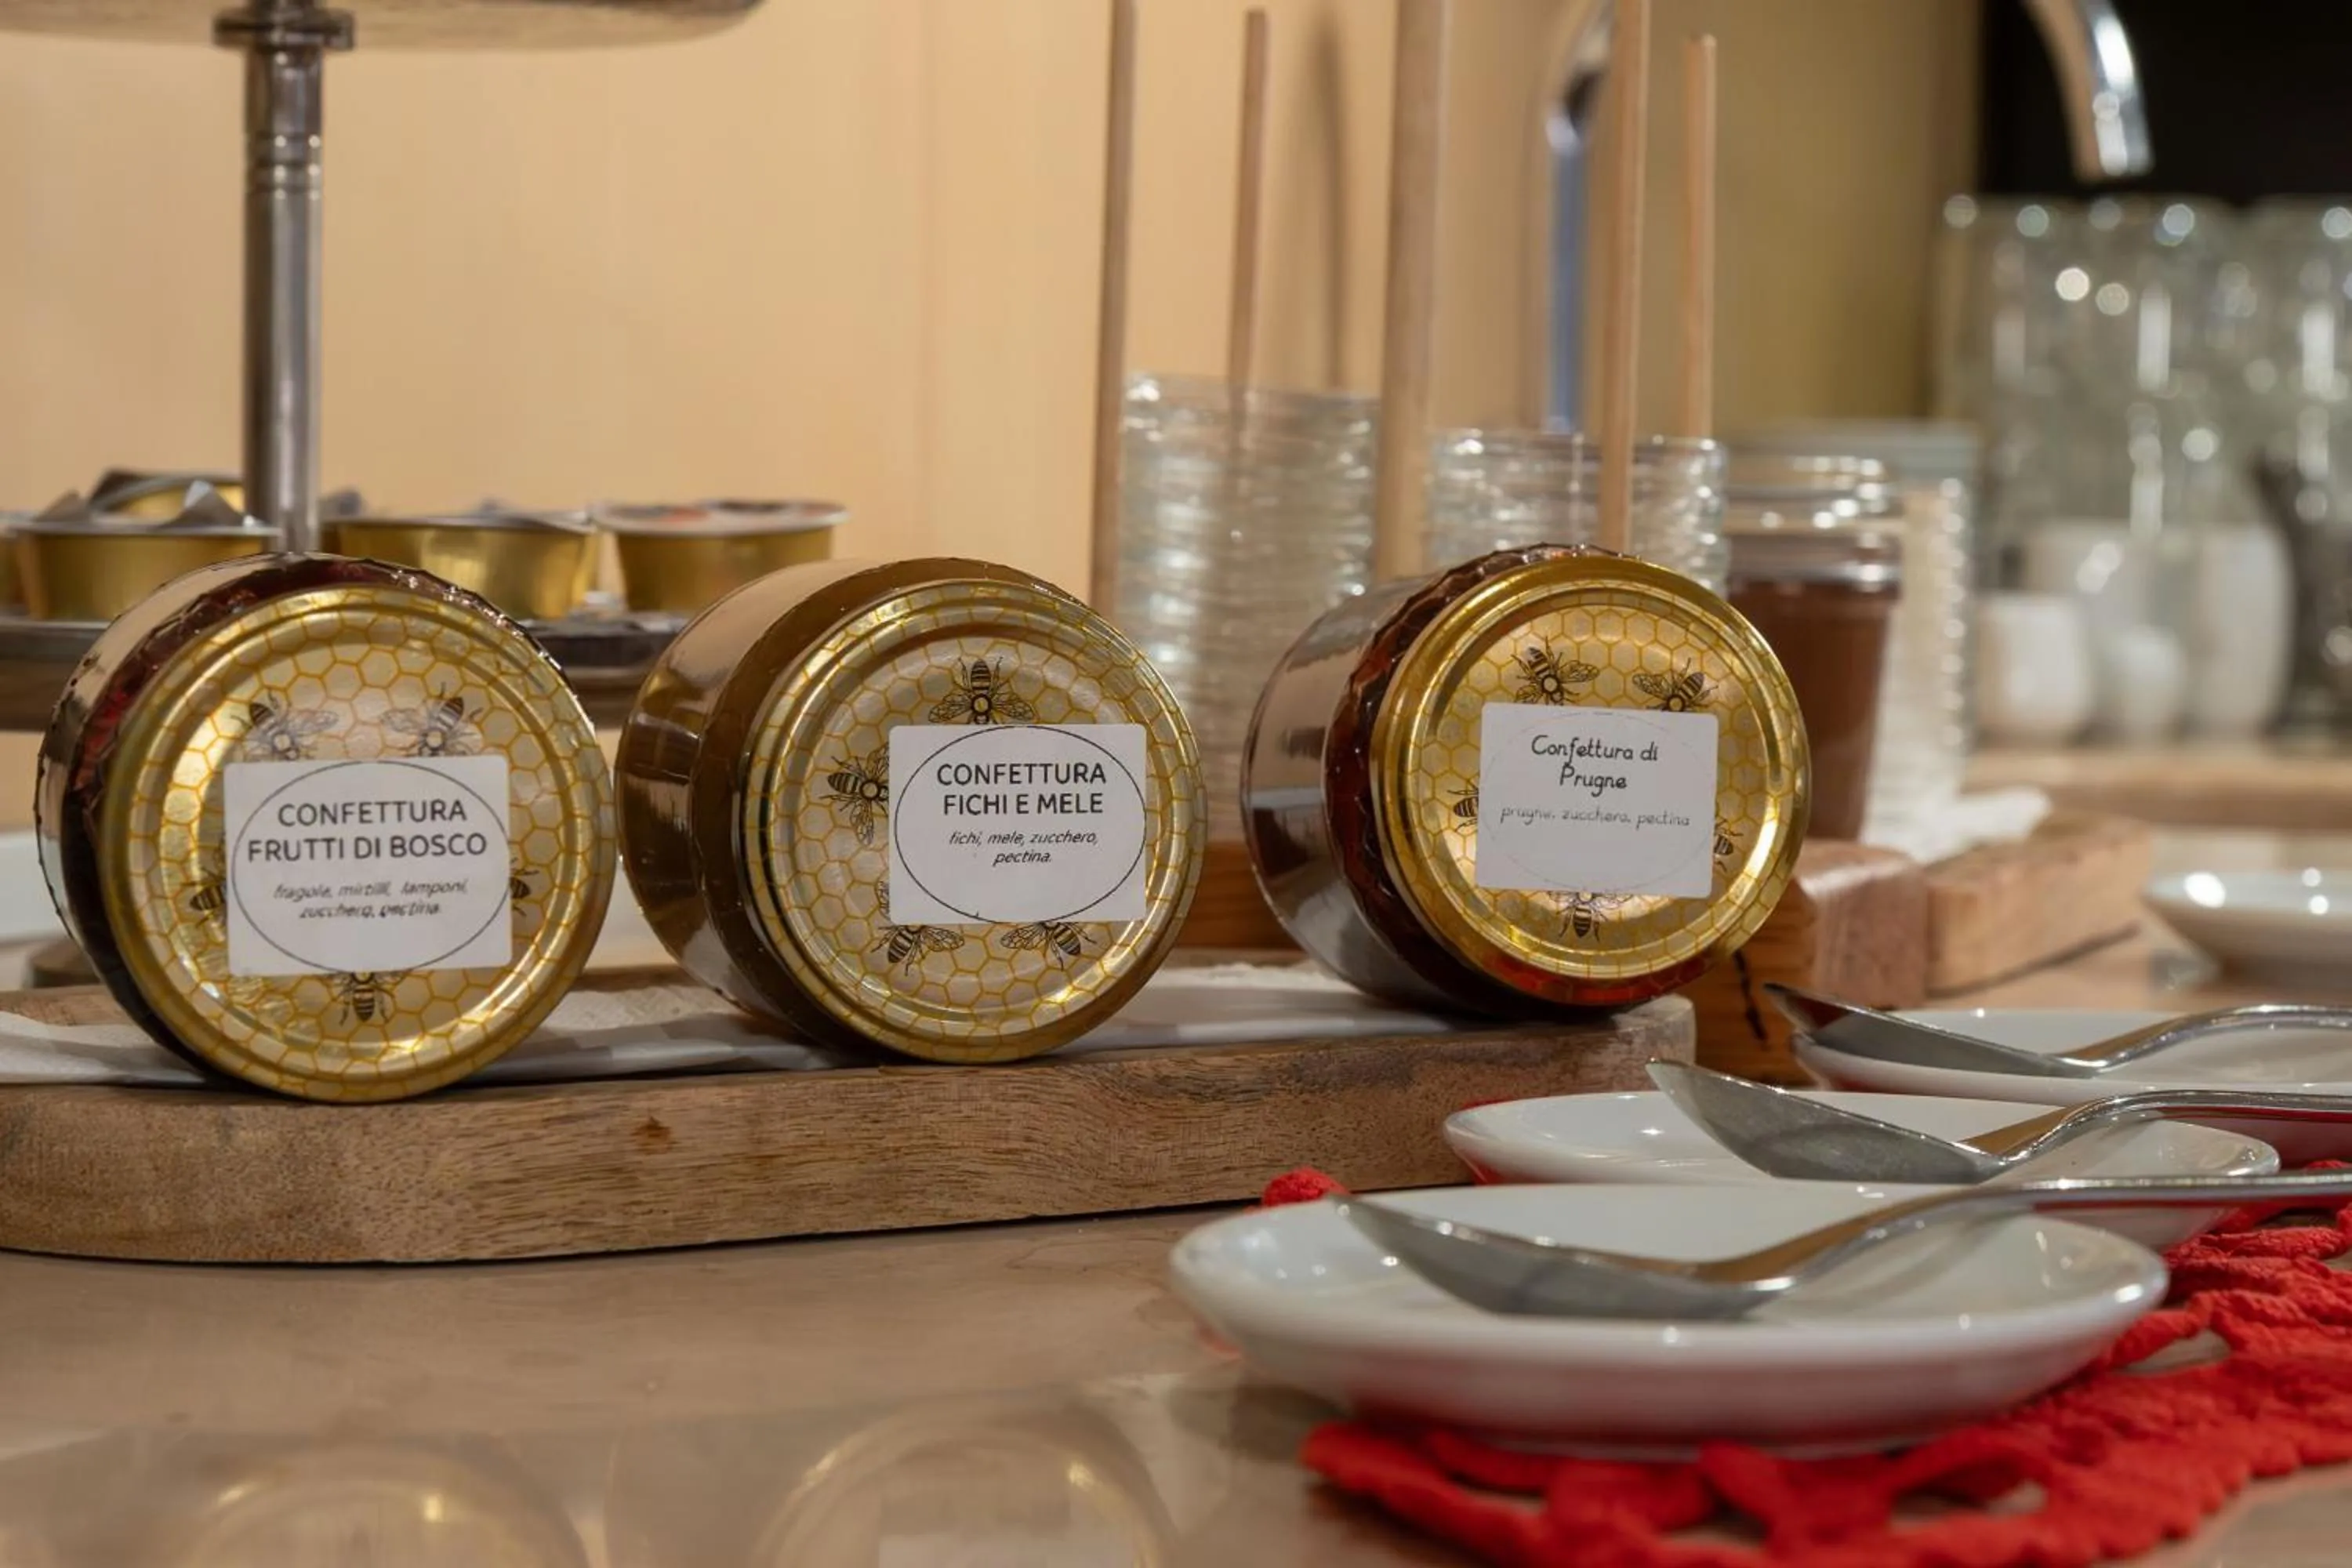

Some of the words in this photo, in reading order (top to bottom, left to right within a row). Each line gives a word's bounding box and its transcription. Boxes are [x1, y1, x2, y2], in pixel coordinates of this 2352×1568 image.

[1531, 734, 1634, 765] Confettura
[1640, 741, 1658, 761] di
[936, 762, 1107, 786] CONFETTURA
[1559, 760, 1628, 798] Prugne
[277, 798, 468, 828] CONFETTURA
[943, 793, 1008, 816] FICHI
[1016, 793, 1030, 815] E
[1036, 793, 1104, 815] MELE
[247, 837, 345, 862] FRUTTI
[354, 837, 381, 859] DI
[390, 832, 488, 858] BOSCO
[949, 830, 982, 846] fichi,
[987, 831, 1025, 846] mele,
[1029, 829, 1098, 846] zucchero,
[993, 849, 1052, 867] pectina.
